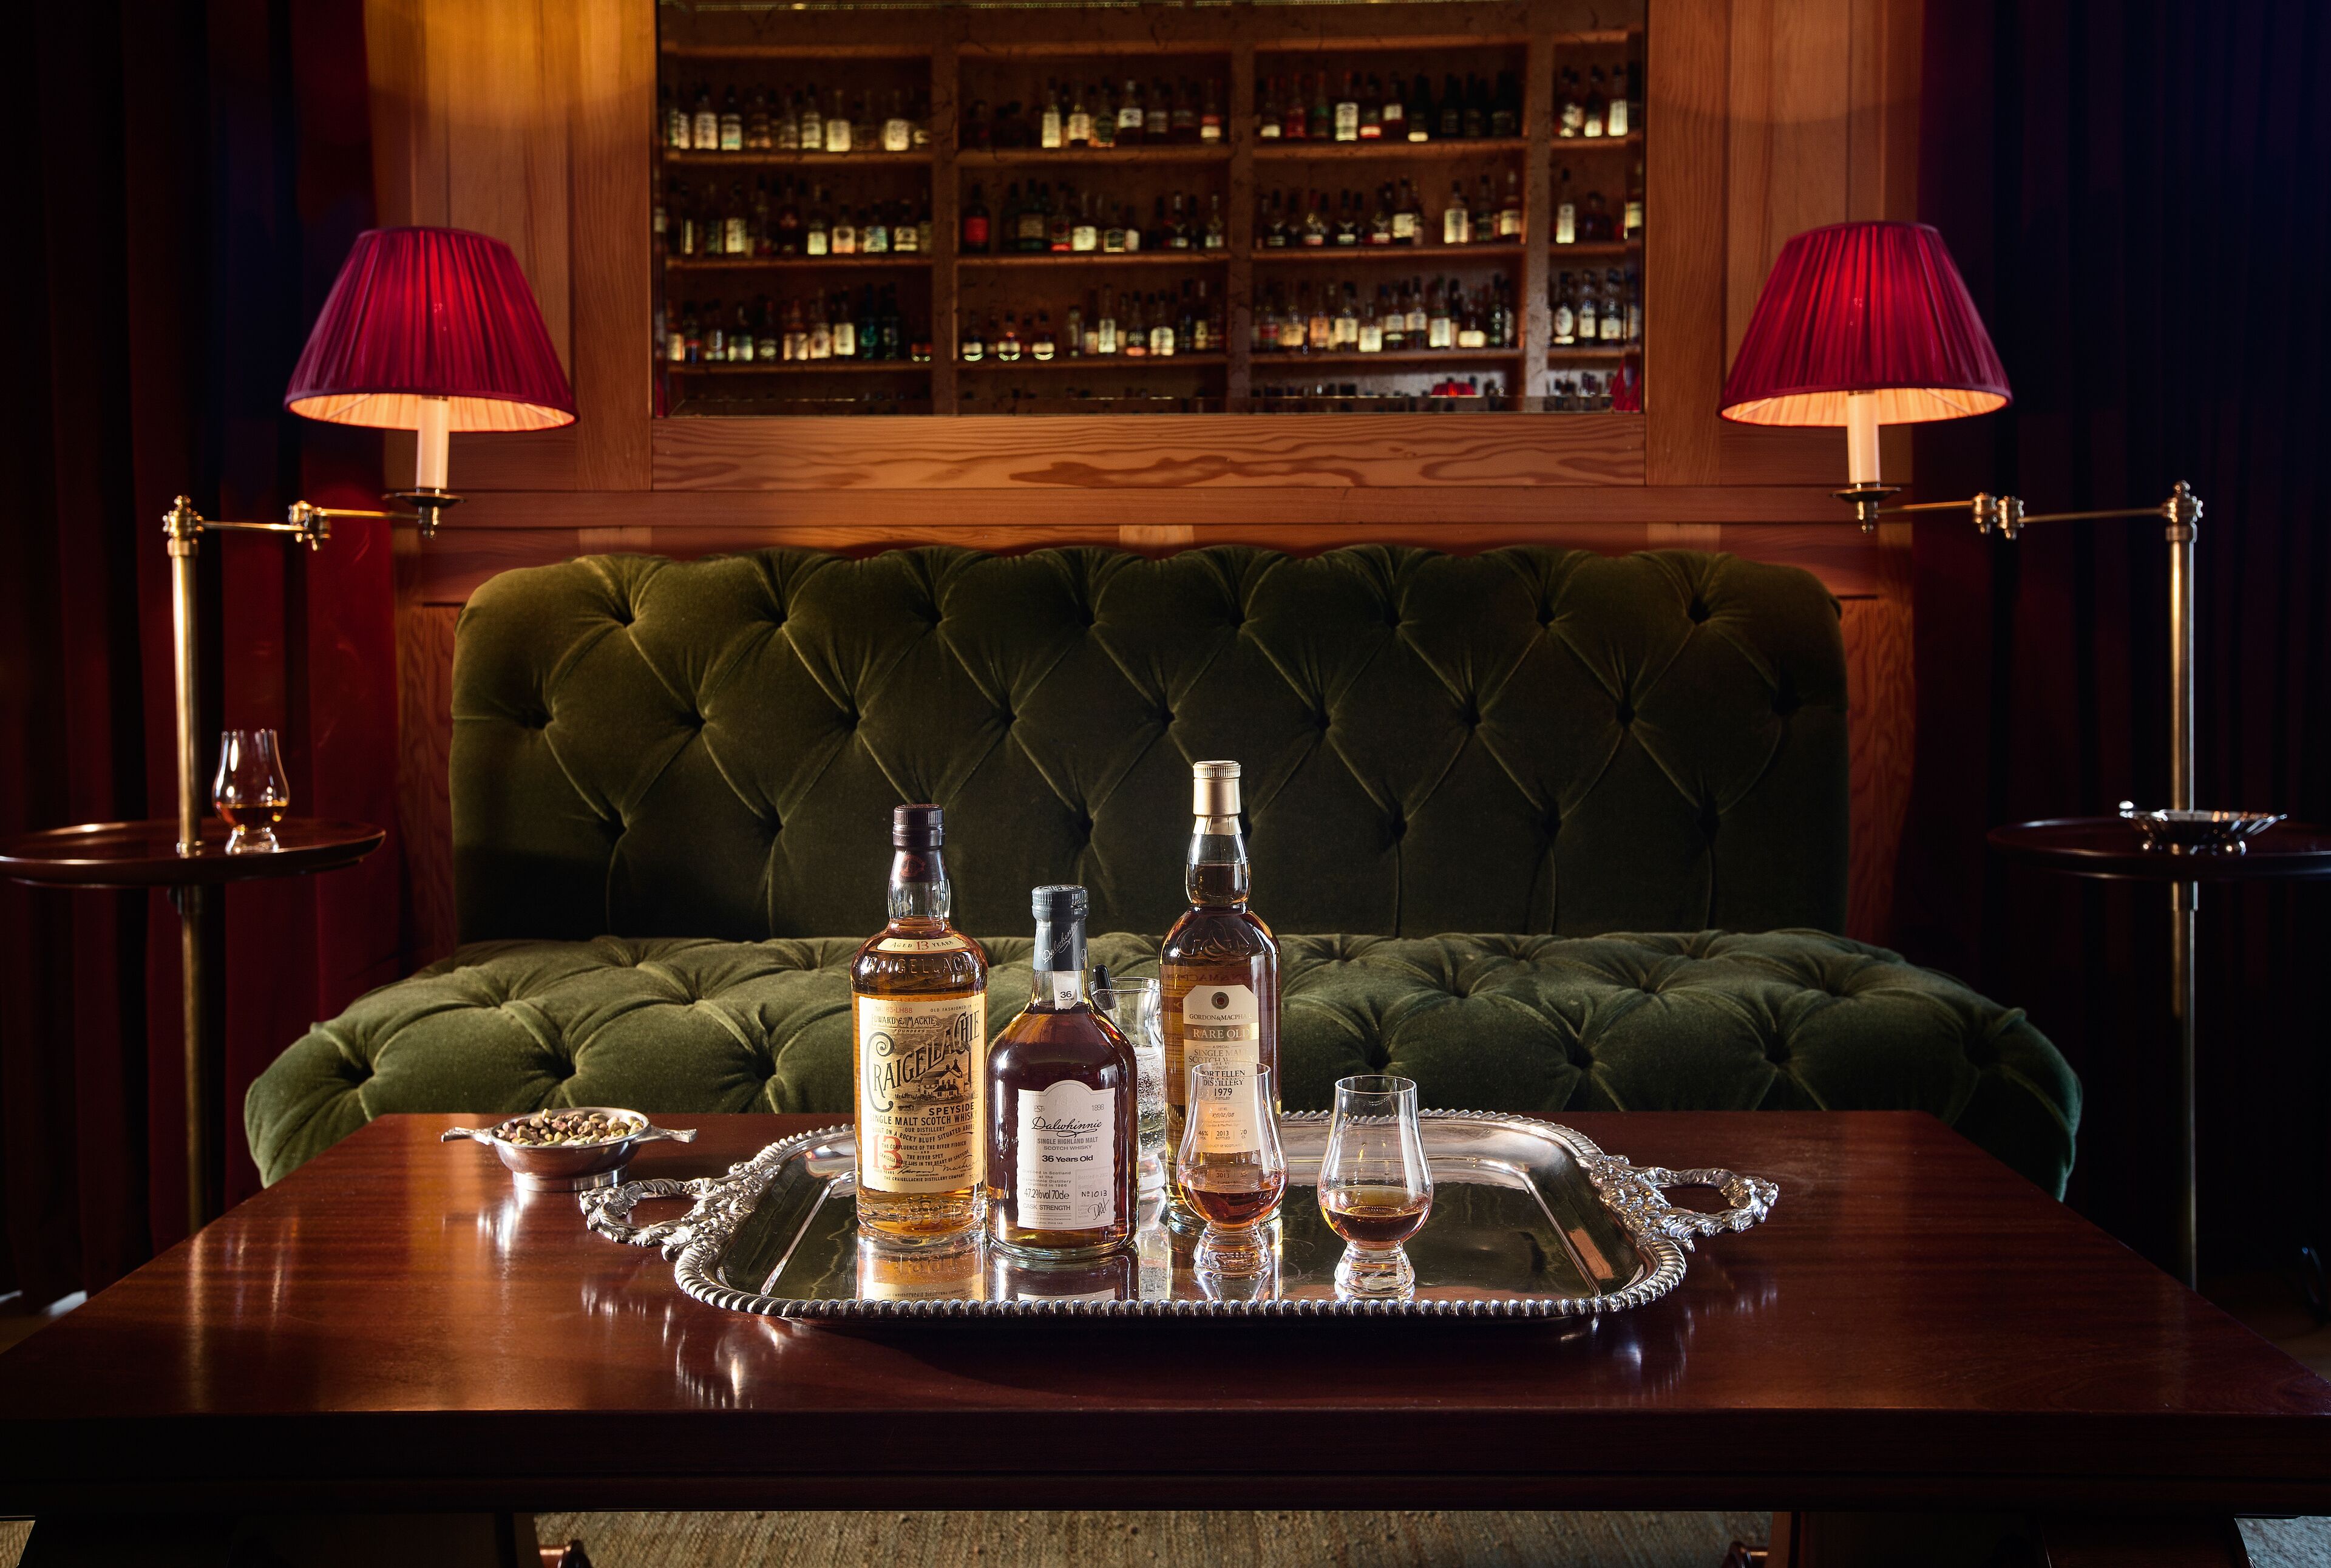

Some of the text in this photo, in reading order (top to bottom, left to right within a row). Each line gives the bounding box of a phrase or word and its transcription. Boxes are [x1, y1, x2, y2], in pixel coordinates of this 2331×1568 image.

[916, 941, 929, 951] 13
[906, 1016, 936, 1026] MACKIE
[1193, 1028, 1250, 1039] RARE OLD
[1194, 1048, 1224, 1057] SINGLE
[867, 1010, 980, 1112] CRAIGELLACHIE
[1189, 1055, 1221, 1064] SCOTCH
[1214, 1087, 1233, 1096] 1979
[929, 1102, 974, 1116] SPEYSIDE
[870, 1110, 977, 1126] SINGLE MALT SCOTCH WHISKY
[1031, 1116, 1103, 1135] Dalwhinnie
[899, 1132, 917, 1142] ROCKY
[937, 1127, 961, 1141] SITUATED
[872, 1134, 904, 1170] 13
